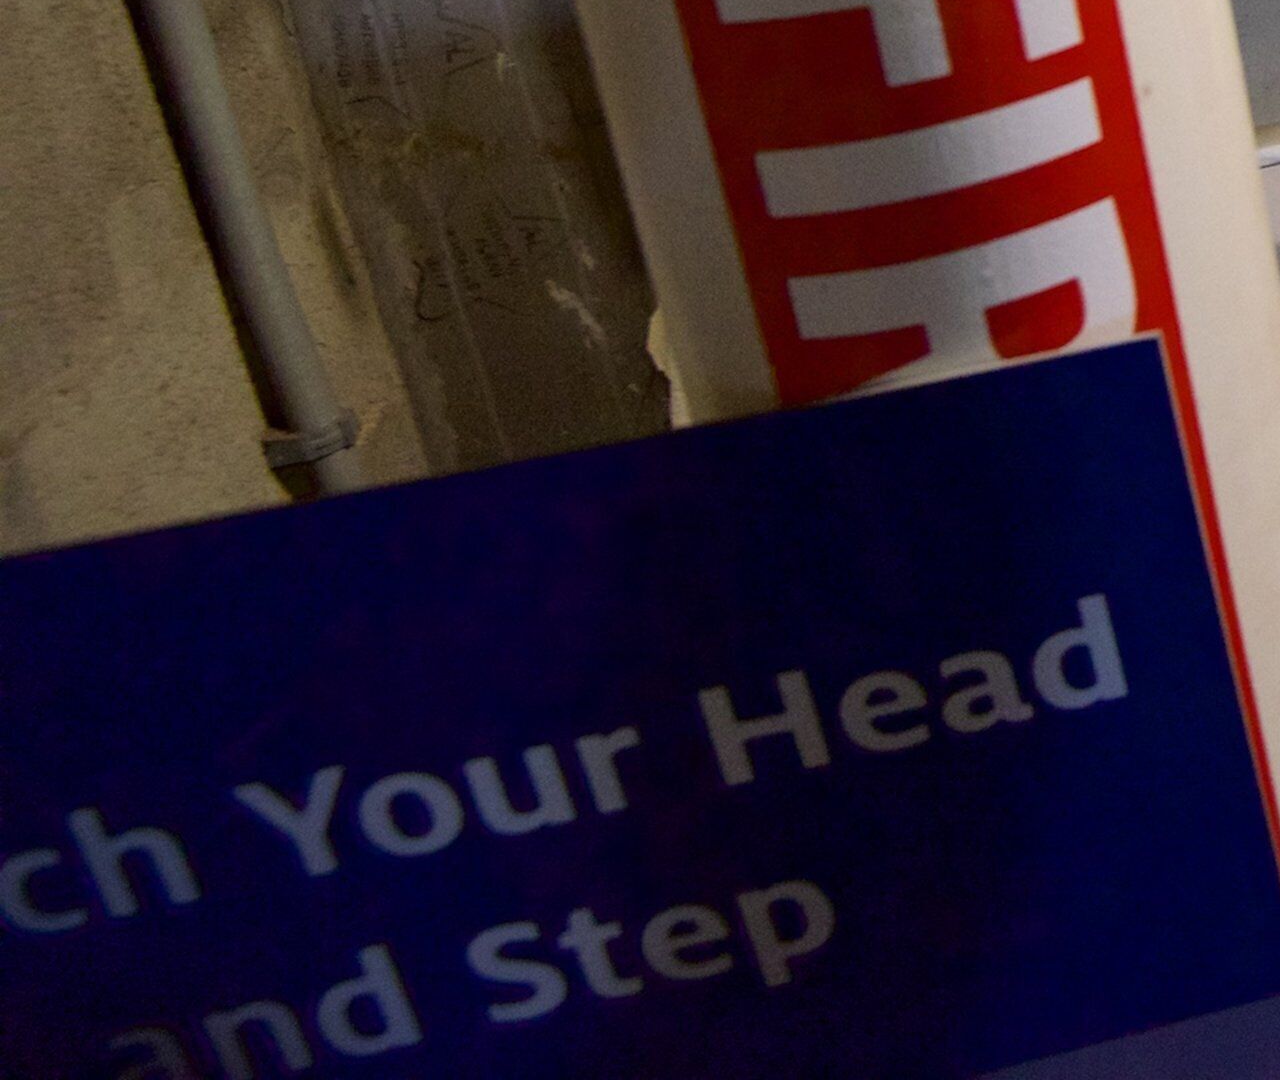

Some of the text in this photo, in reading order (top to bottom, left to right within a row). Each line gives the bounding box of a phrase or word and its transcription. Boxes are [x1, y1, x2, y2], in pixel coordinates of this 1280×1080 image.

[236, 727, 640, 877] Your
[697, 594, 1129, 786] Head
[107, 878, 836, 1080] and Step
